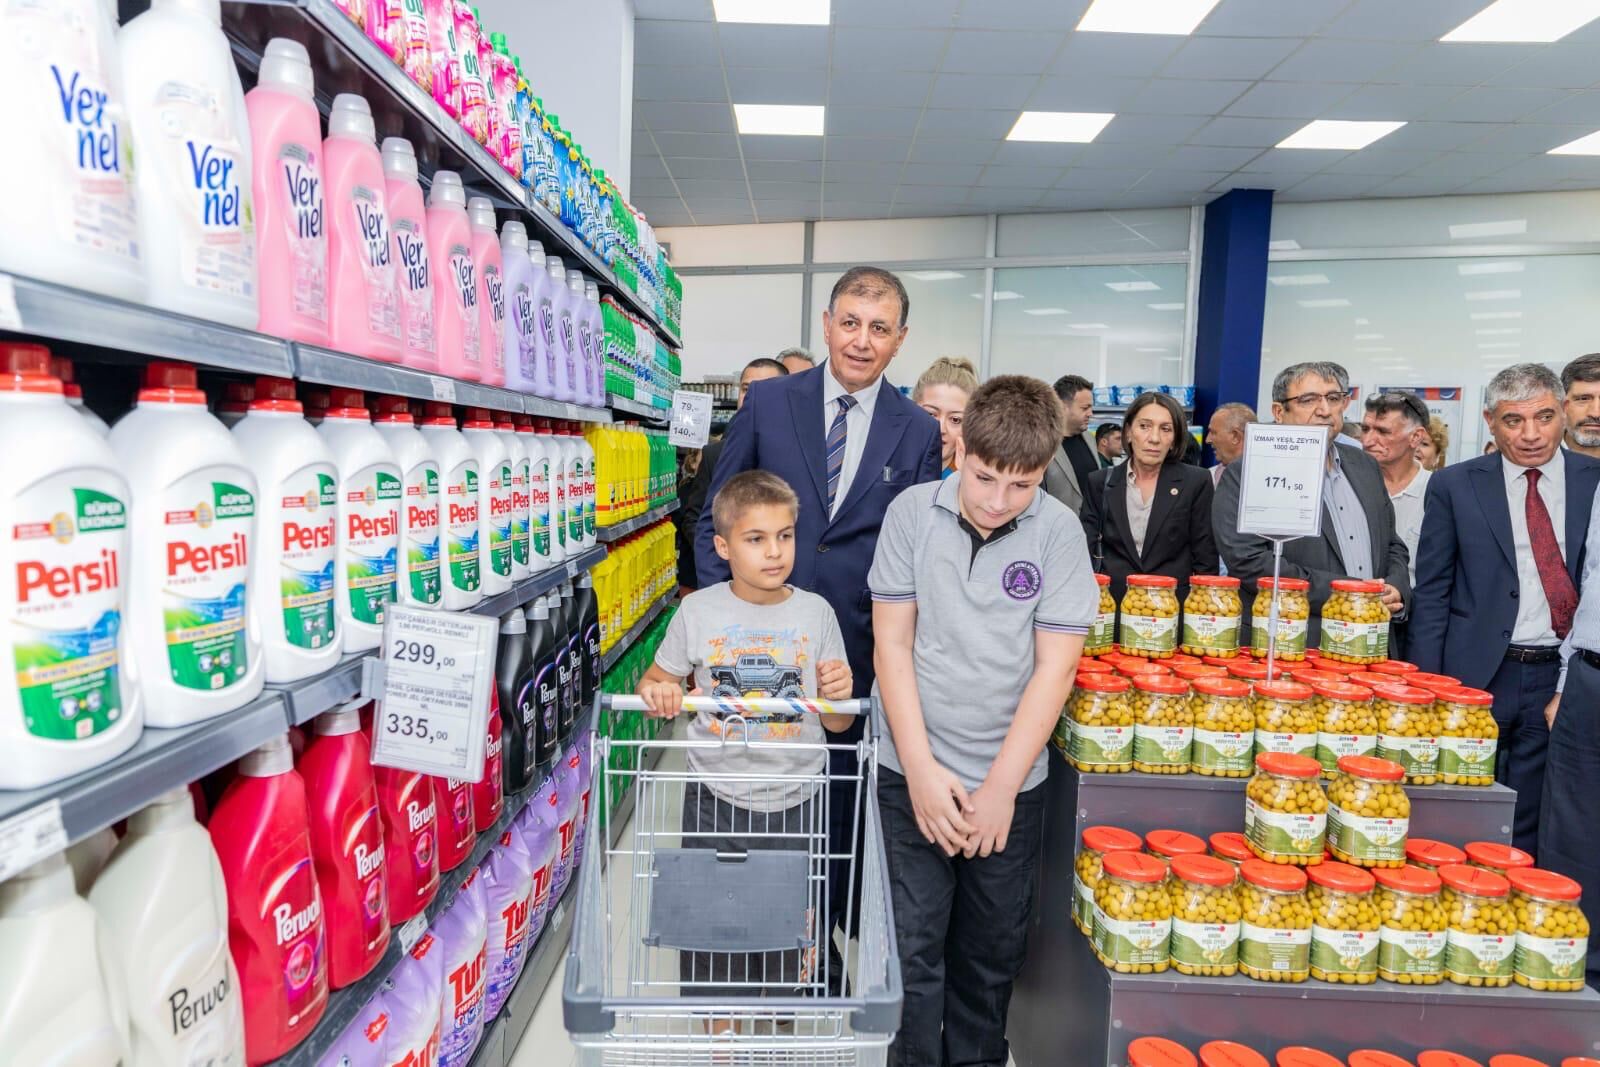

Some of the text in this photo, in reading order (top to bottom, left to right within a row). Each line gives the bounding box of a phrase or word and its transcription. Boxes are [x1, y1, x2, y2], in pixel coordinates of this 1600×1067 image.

[51, 65, 107, 128] Ver
[77, 124, 120, 173] nel
[186, 141, 233, 190] Ver
[285, 164, 319, 207] Ver
[204, 186, 239, 227] nel
[299, 198, 322, 239] nel
[356, 203, 384, 240] Ver
[369, 231, 391, 267] nel
[397, 234, 424, 267] Ver
[409, 258, 428, 291] nel
[453, 257, 474, 290] Ver
[486, 276, 502, 305] Ver
[518, 295, 532, 320] Ver
[512, 491, 529, 509] Pers
[532, 488, 549, 504] Pers
[568, 482, 583, 497] Persi
[584, 481, 595, 494] Pers
[408, 503, 439, 528] Persi
[449, 499, 479, 524] Persi
[490, 496, 511, 515] Persi
[282, 518, 336, 551] Persil
[347, 510, 398, 540] Persil
[167, 532, 247, 576] Persil
[16, 549, 119, 603] Persil
[273, 882, 320, 945] Perwol
[168, 960, 231, 1036] Perwol
